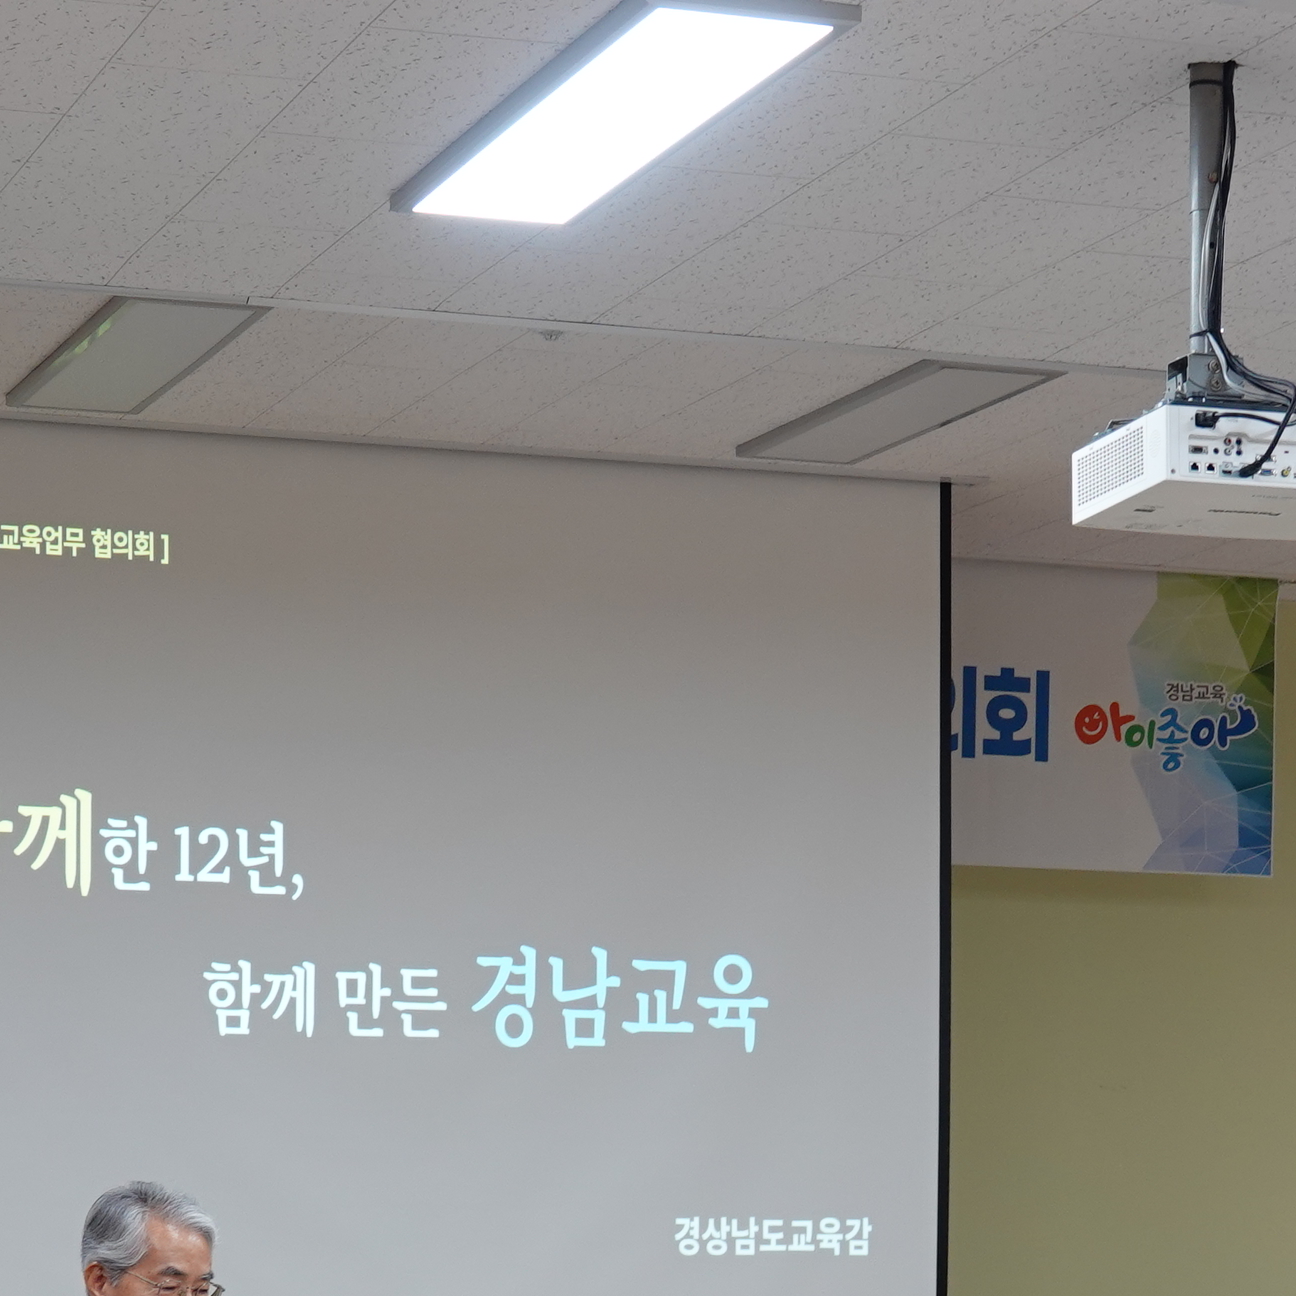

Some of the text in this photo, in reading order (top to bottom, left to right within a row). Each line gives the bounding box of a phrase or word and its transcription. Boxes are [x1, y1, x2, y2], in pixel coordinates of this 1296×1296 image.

[1165, 683, 1226, 704] 경남교육
[1074, 701, 1257, 772] 아이좋아
[174, 820, 304, 900] 12년,
[203, 944, 769, 1053] 함께 만든 경남교육
[674, 1216, 872, 1257] 경상남도교육감
